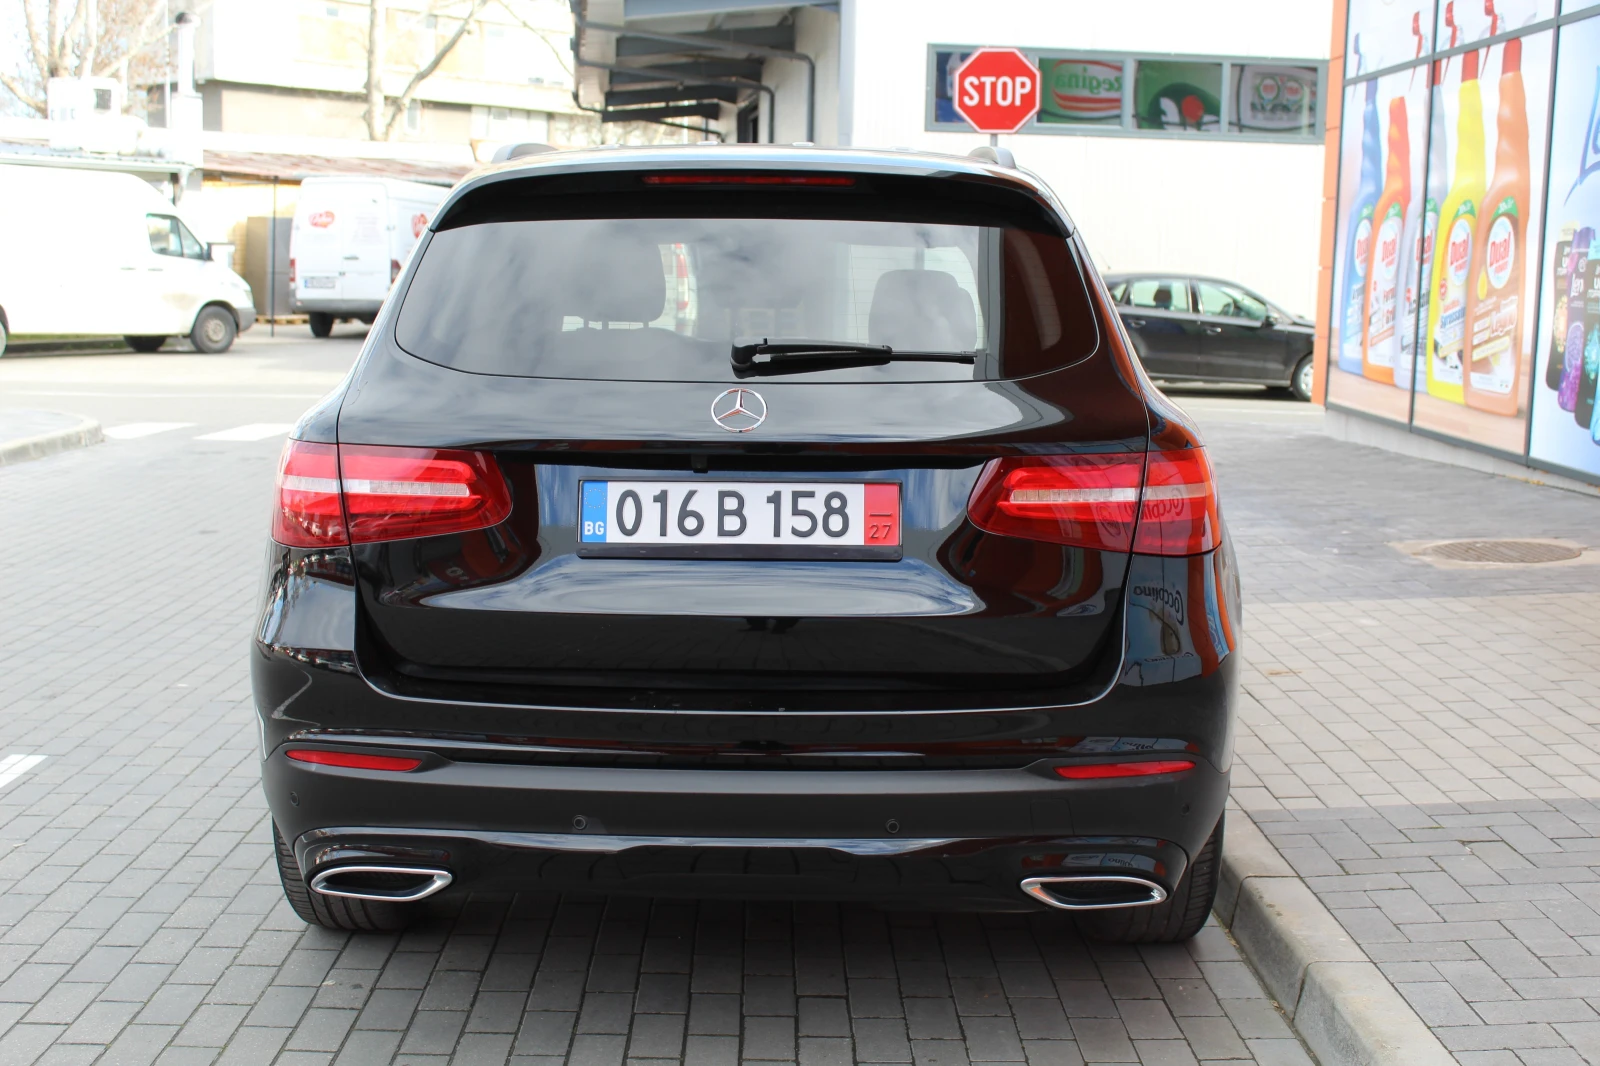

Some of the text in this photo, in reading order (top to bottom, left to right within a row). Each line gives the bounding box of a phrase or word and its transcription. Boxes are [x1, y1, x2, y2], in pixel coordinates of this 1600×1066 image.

[963, 75, 1032, 106] STOP
[616, 489, 850, 538] 016 B 158
[584, 521, 605, 535] BG
[869, 524, 892, 540] 27
